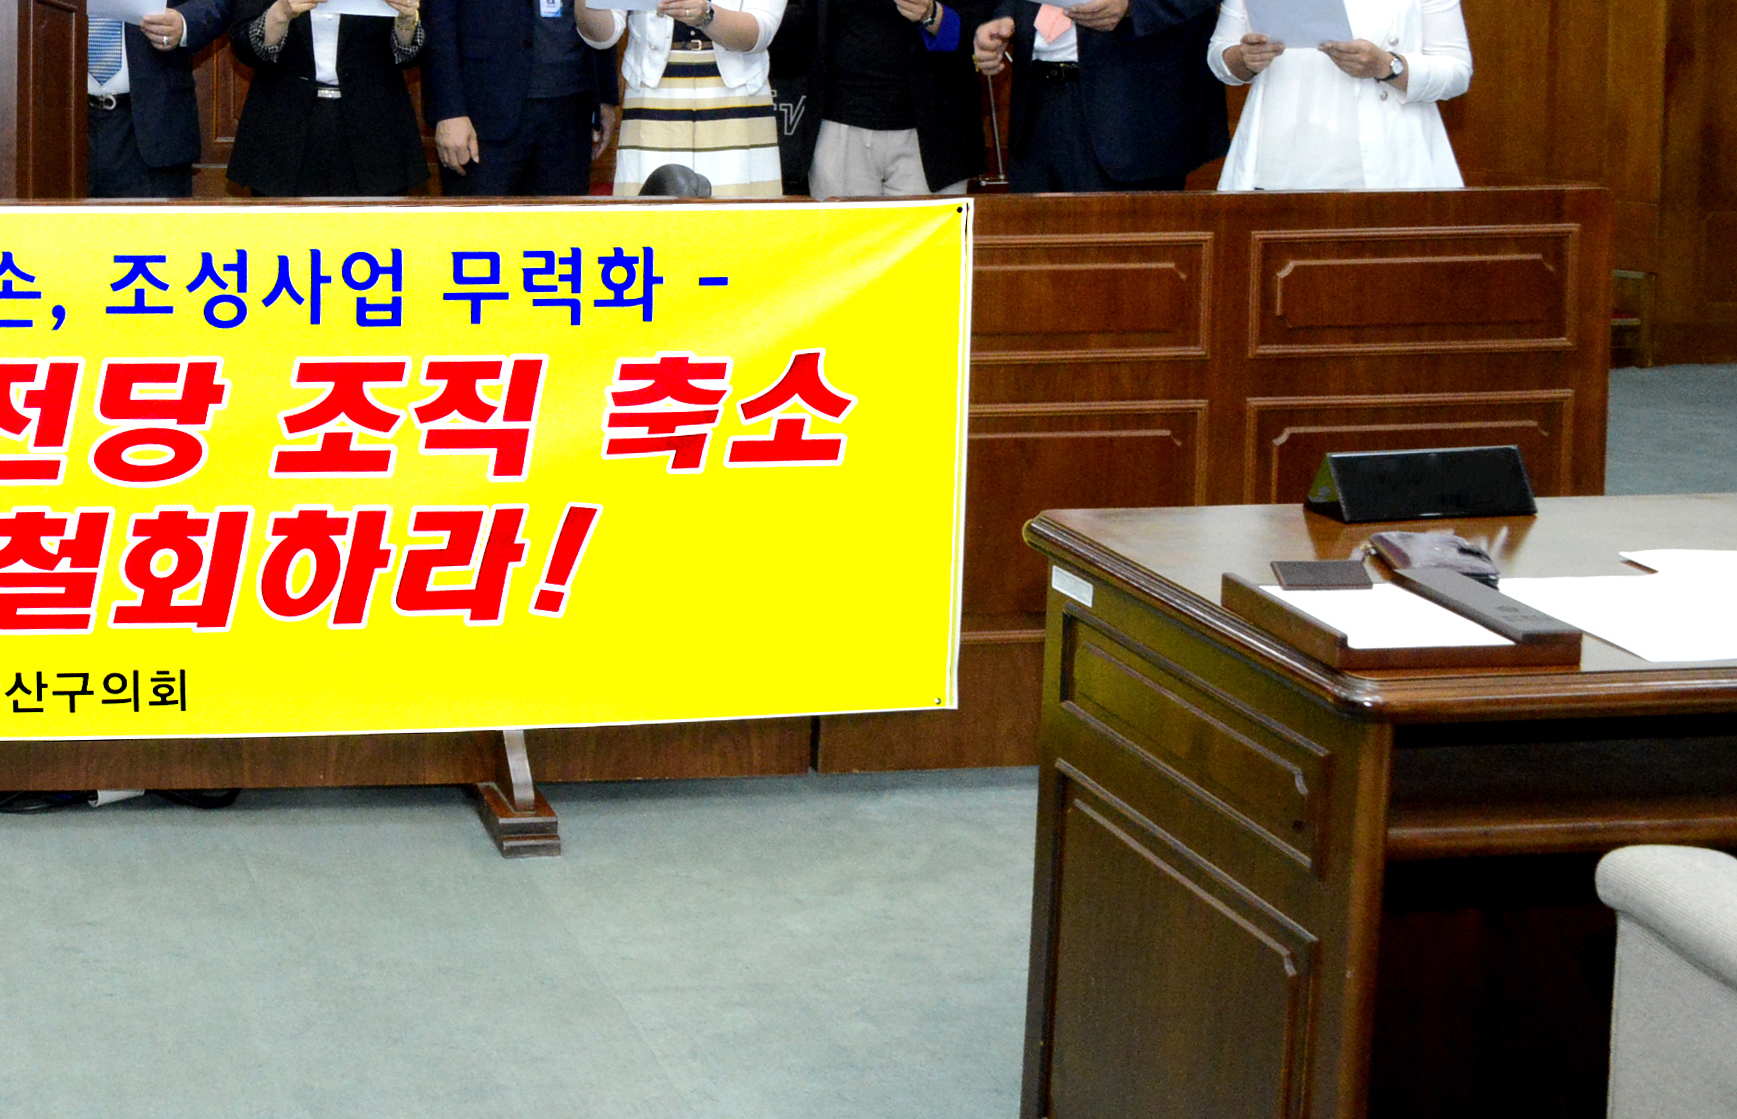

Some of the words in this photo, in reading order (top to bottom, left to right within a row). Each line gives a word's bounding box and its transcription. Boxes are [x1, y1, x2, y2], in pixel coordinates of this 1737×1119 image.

[106, 248, 403, 329] 조성사업
[443, 246, 664, 326] 무력화
[271, 355, 546, 480] 조직
[603, 349, 855, 472] 축소
